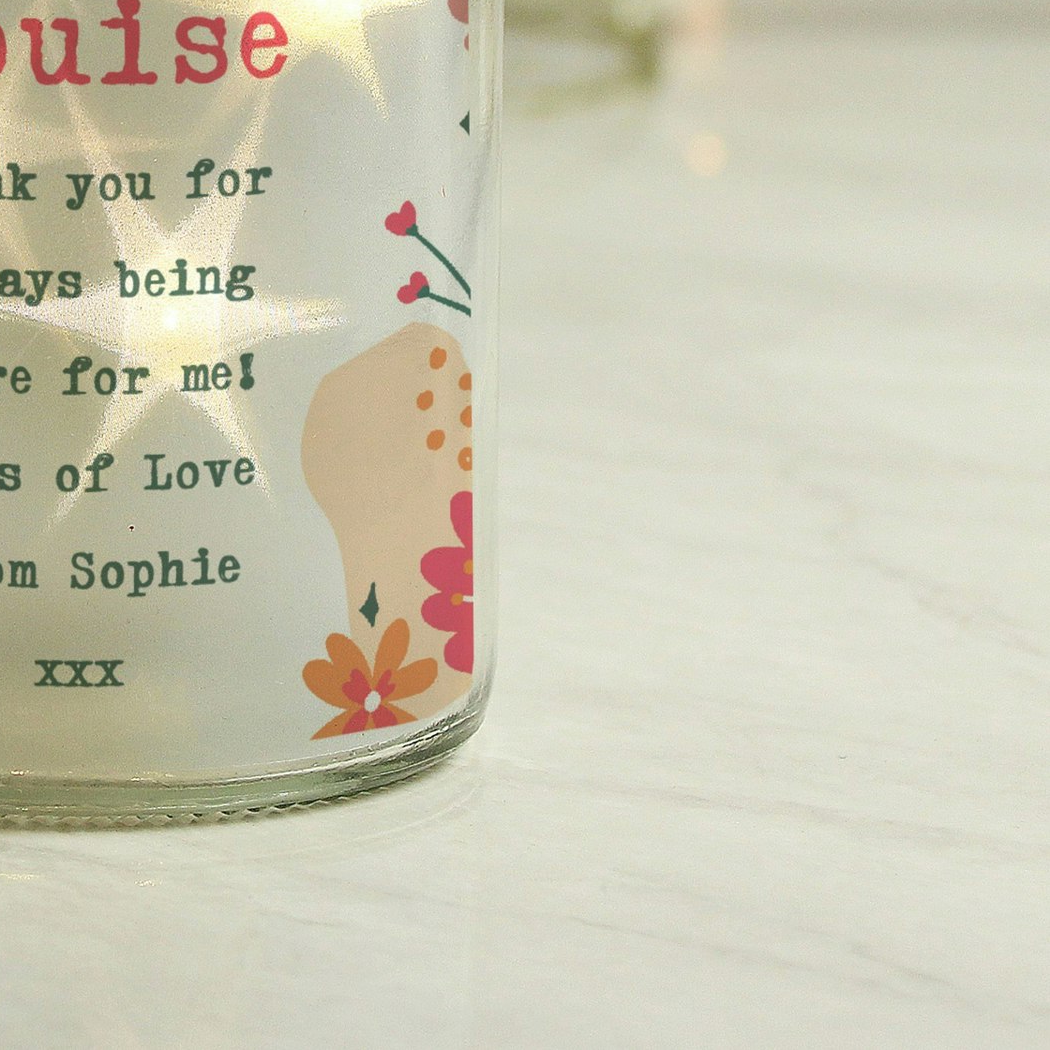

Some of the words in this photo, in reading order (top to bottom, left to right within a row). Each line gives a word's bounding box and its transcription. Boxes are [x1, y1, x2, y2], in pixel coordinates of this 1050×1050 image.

[65, 169, 156, 210] you
[185, 158, 273, 200] for
[113, 258, 256, 302] being
[61, 356, 150, 397] for
[180, 353, 256, 393] me!
[55, 452, 115, 494] of
[143, 453, 255, 492] Love
[69, 547, 241, 597] Sophie
[33, 659, 124, 688] xxx
